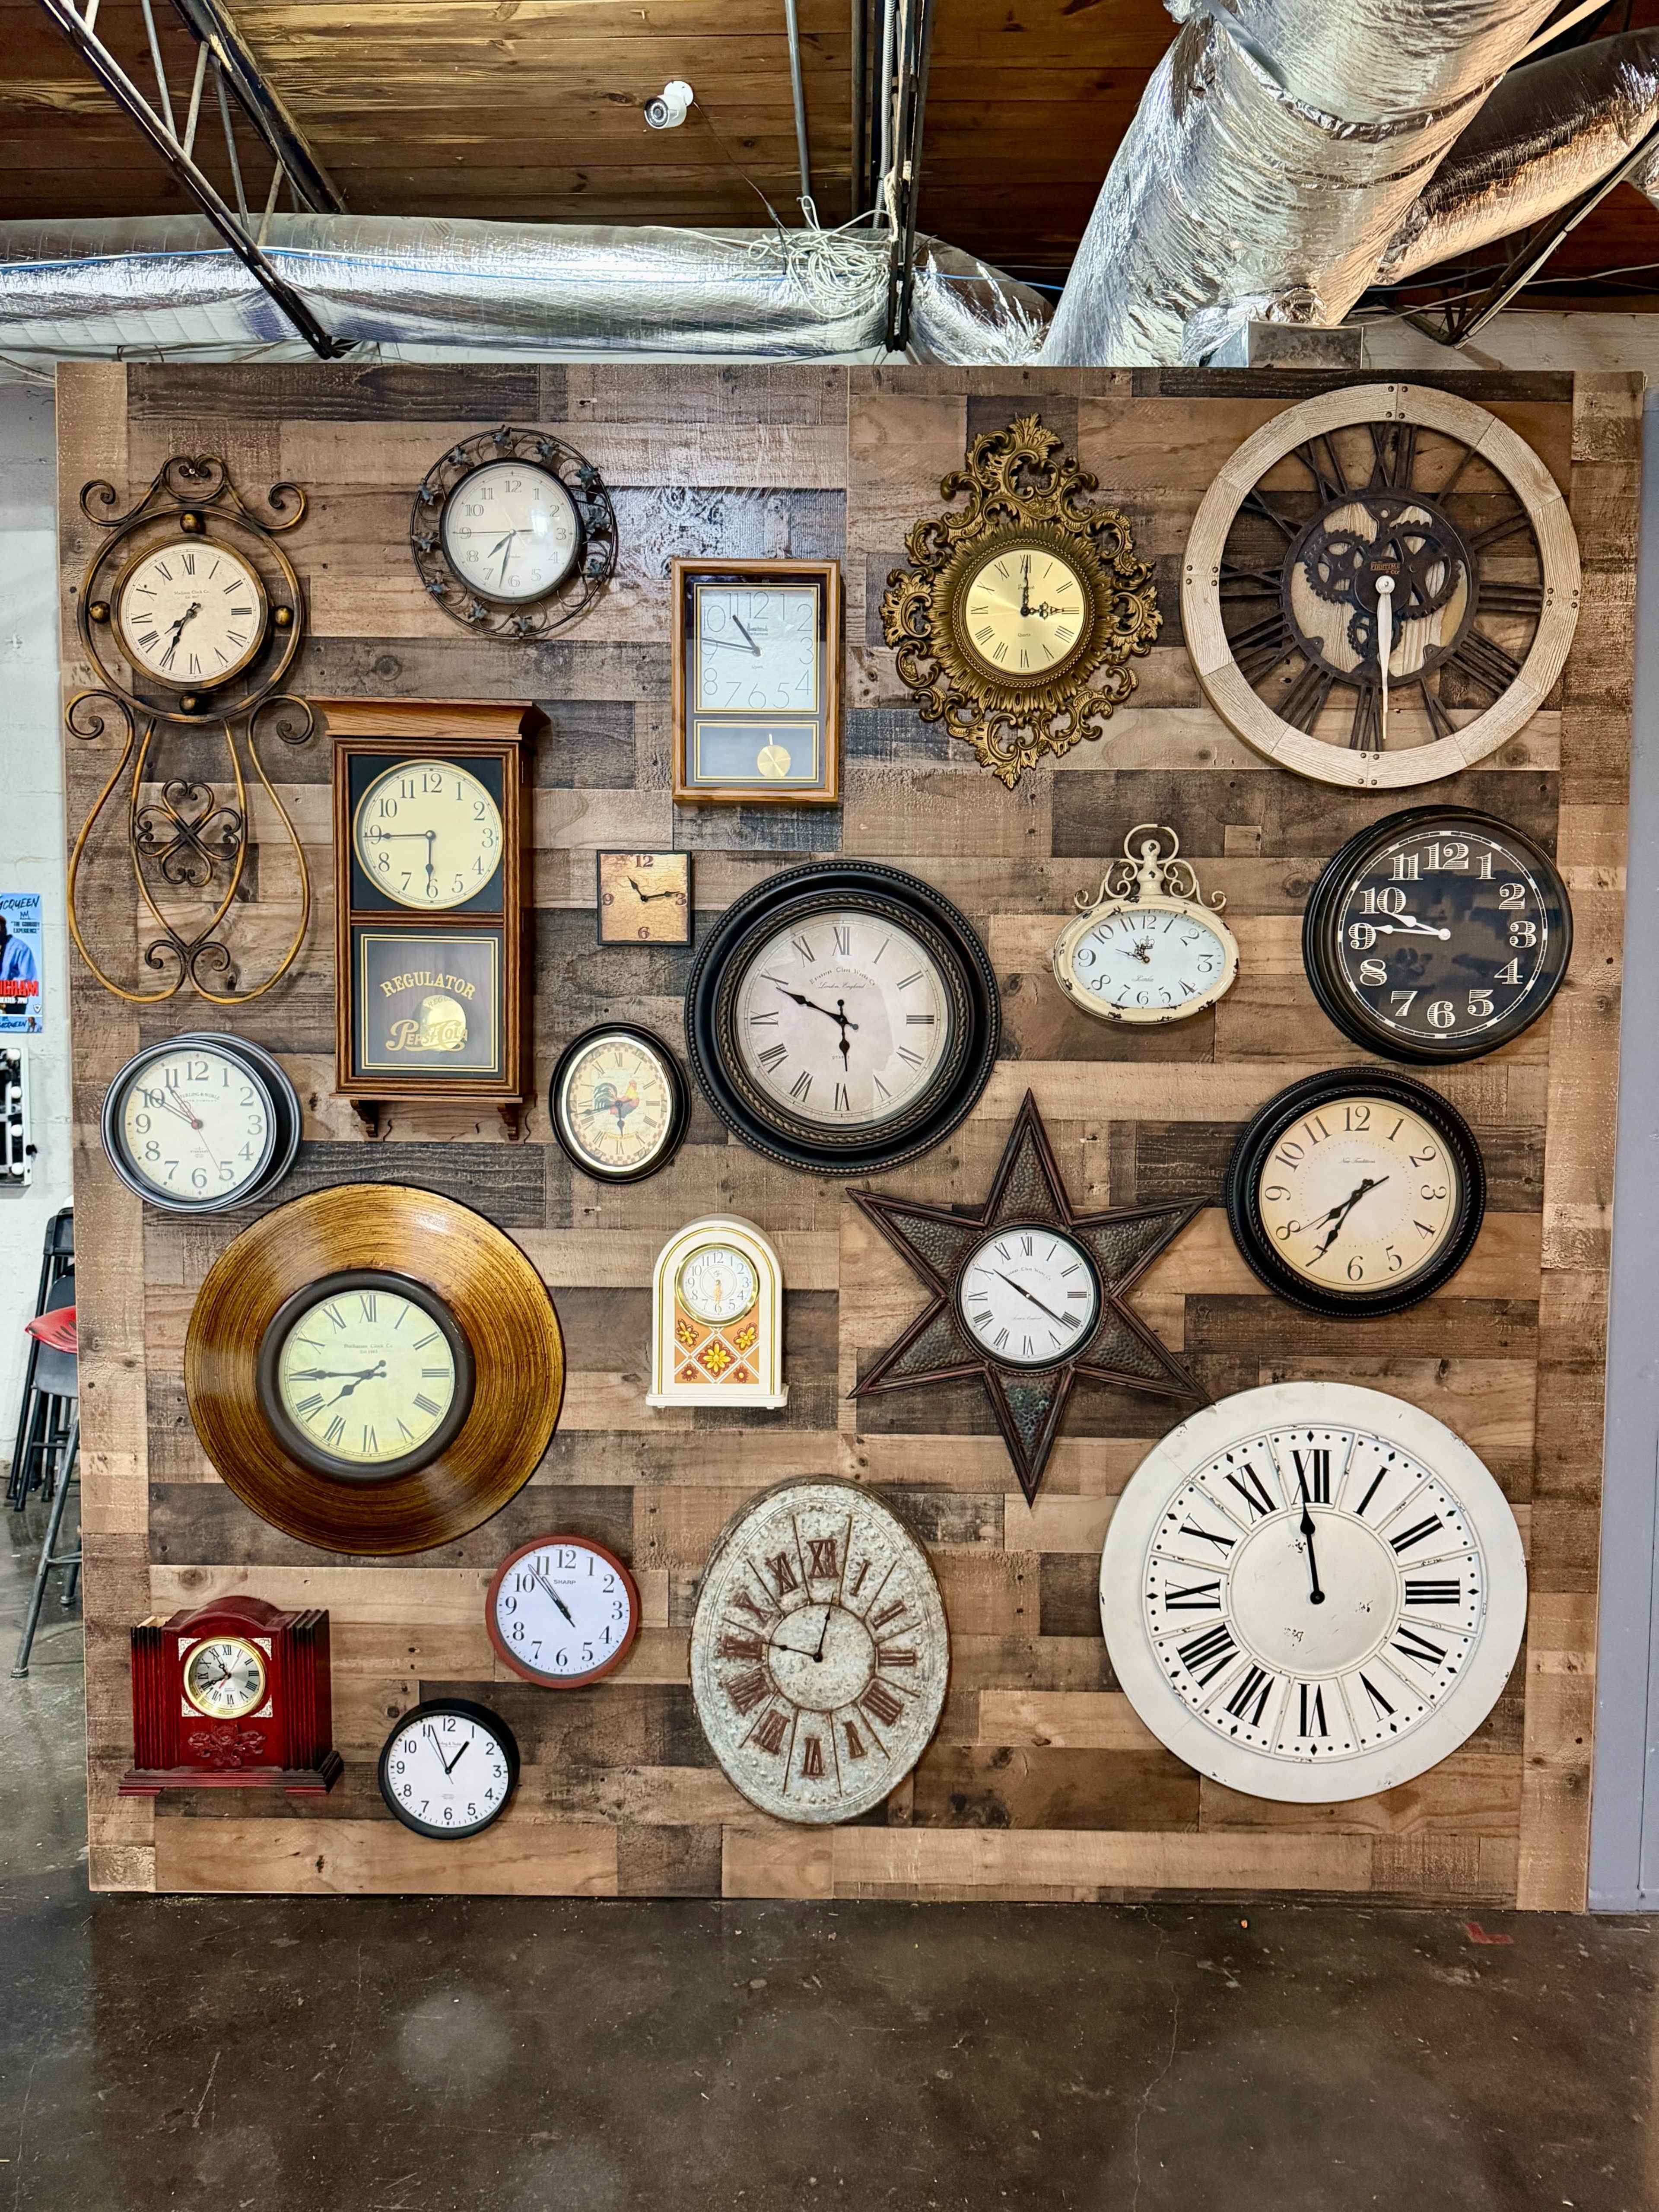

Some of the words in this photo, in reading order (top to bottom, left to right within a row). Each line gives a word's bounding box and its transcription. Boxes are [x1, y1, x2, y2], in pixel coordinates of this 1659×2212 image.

[481, 488, 494, 500] 11
[505, 481, 522, 493] 12
[534, 488, 540, 500] 1
[465, 504, 484, 516] 10
[550, 505, 559, 517] 2
[556, 528, 566, 540] 3
[467, 551, 479, 562] 8
[483, 568, 494, 580] 7
[509, 576, 520, 587] 6
[727, 593, 738, 618] 11
[747, 592, 769, 618] 12
[780, 594, 785, 620] 1
[702, 605, 725, 632] 10
[797, 604, 812, 631] 2
[799, 637, 814, 664] 3
[703, 668, 718, 695] 8
[795, 670, 811, 695] 4
[725, 682, 741, 707] 7
[748, 684, 766, 708] 6
[773, 683, 789, 709] 5
[400, 780, 416, 799] 11
[422, 773, 442, 793] 12
[456, 782, 463, 801] 1
[379, 799, 397, 818] 10
[474, 802, 485, 821] 2
[482, 828, 493, 848] 3
[378, 853, 390, 872] 8
[636, 856, 653, 867] 12
[1424, 842, 1468, 869] 12
[472, 856, 484, 875] 4
[1388, 853, 1423, 880] 11
[1476, 853, 1496, 879] 1
[401, 872, 412, 891] 7
[426, 878, 438, 898] 6
[452, 874, 463, 893] 5
[602, 893, 614, 906] 9
[676, 893, 686, 906] 3
[1360, 887, 1406, 914] 10
[1499, 883, 1526, 910] 2
[1120, 917, 1135, 932] 11
[1142, 915, 1156, 929] 12
[1163, 920, 1174, 933] 1
[638, 927, 650, 939] 6
[832, 926, 852, 955] XII
[1092, 924, 1114, 944] 10
[1180, 929, 1200, 946] 2
[1348, 923, 1376, 950] 9
[1510, 921, 1536, 948] 3
[1078, 948, 1096, 967] 9
[1198, 955, 1214, 972] 3
[1360, 959, 1387, 986] 8
[1494, 958, 1523, 984] 4
[380, 971, 476, 1000] REGULATOR
[1091, 974, 1111, 990] 8
[1178, 978, 1198, 996] 4
[1117, 984, 1130, 1001] 7
[1137, 991, 1149, 1005] 6
[1159, 987, 1171, 1003] 5
[1391, 991, 1417, 1016] 7
[1468, 990, 1494, 1016] 5
[1427, 1001, 1455, 1028] 6
[165, 1068, 180, 1088] 11
[187, 1061, 209, 1081] 12
[222, 1068, 229, 1087] 1
[240, 1087, 254, 1106] 2
[136, 1114, 151, 1134] 9
[248, 1114, 262, 1135] 3
[1343, 1105, 1370, 1131] 12
[1302, 1116, 1332, 1145] 11
[1386, 1118, 1404, 1142] 1
[145, 1141, 160, 1161] 8
[238, 1142, 254, 1161] 4
[1274, 1142, 1305, 1172] 10
[1409, 1146, 1436, 1168] 2
[164, 1161, 178, 1180] 7
[192, 1168, 207, 1187] 6
[219, 1161, 234, 1181] 5
[1265, 1185, 1291, 1200] 9
[1421, 1184, 1446, 1200] 3
[1276, 1220, 1301, 1240] 8
[1413, 1219, 1436, 1240] 4
[1020, 1237, 1032, 1256] XII
[702, 1256, 709, 1266] 11
[713, 1252, 723, 1264] 12
[730, 1256, 733, 1266] 1
[1386, 1245, 1402, 1271] 5
[692, 1265, 702, 1276] 10
[737, 1264, 744, 1274] 2
[1347, 1256, 1363, 1281] 6
[688, 1278, 695, 1288] 9
[742, 1277, 749, 1288] 3
[692, 1289, 698, 1300] 8
[360, 1295, 377, 1323] XII
[1290, 1449, 1333, 1505] XII
[1224, 1462, 1279, 1525] XI
[1179, 1514, 1236, 1558] X
[1387, 1514, 1446, 1556] II
[534, 1556, 550, 1575] 11
[556, 1549, 576, 1569] 12
[587, 1556, 594, 1576] 1
[515, 1573, 535, 1592] 10
[603, 1574, 614, 1593] 2
[1405, 1581, 1460, 1605] III
[505, 1596, 517, 1615] 9
[611, 1601, 623, 1620] 3
[513, 1622, 524, 1641] 8
[599, 1626, 612, 1644] 4
[531, 1641, 542, 1659] 7
[556, 1648, 568, 1666] 6
[582, 1642, 593, 1661] 5
[423, 1724, 430, 1737] 11
[443, 1718, 456, 1732] 12
[472, 1725, 474, 1738] 1
[404, 1740, 417, 1753] 10
[486, 1742, 494, 1755] 2
[397, 1761, 404, 1774] 9
[493, 1765, 502, 1778] 3
[404, 1784, 412, 1797] 8
[485, 1788, 493, 1800] 4
[421, 1801, 429, 1813] 7
[444, 1808, 452, 1820] 6
[467, 1803, 476, 1815] 5
